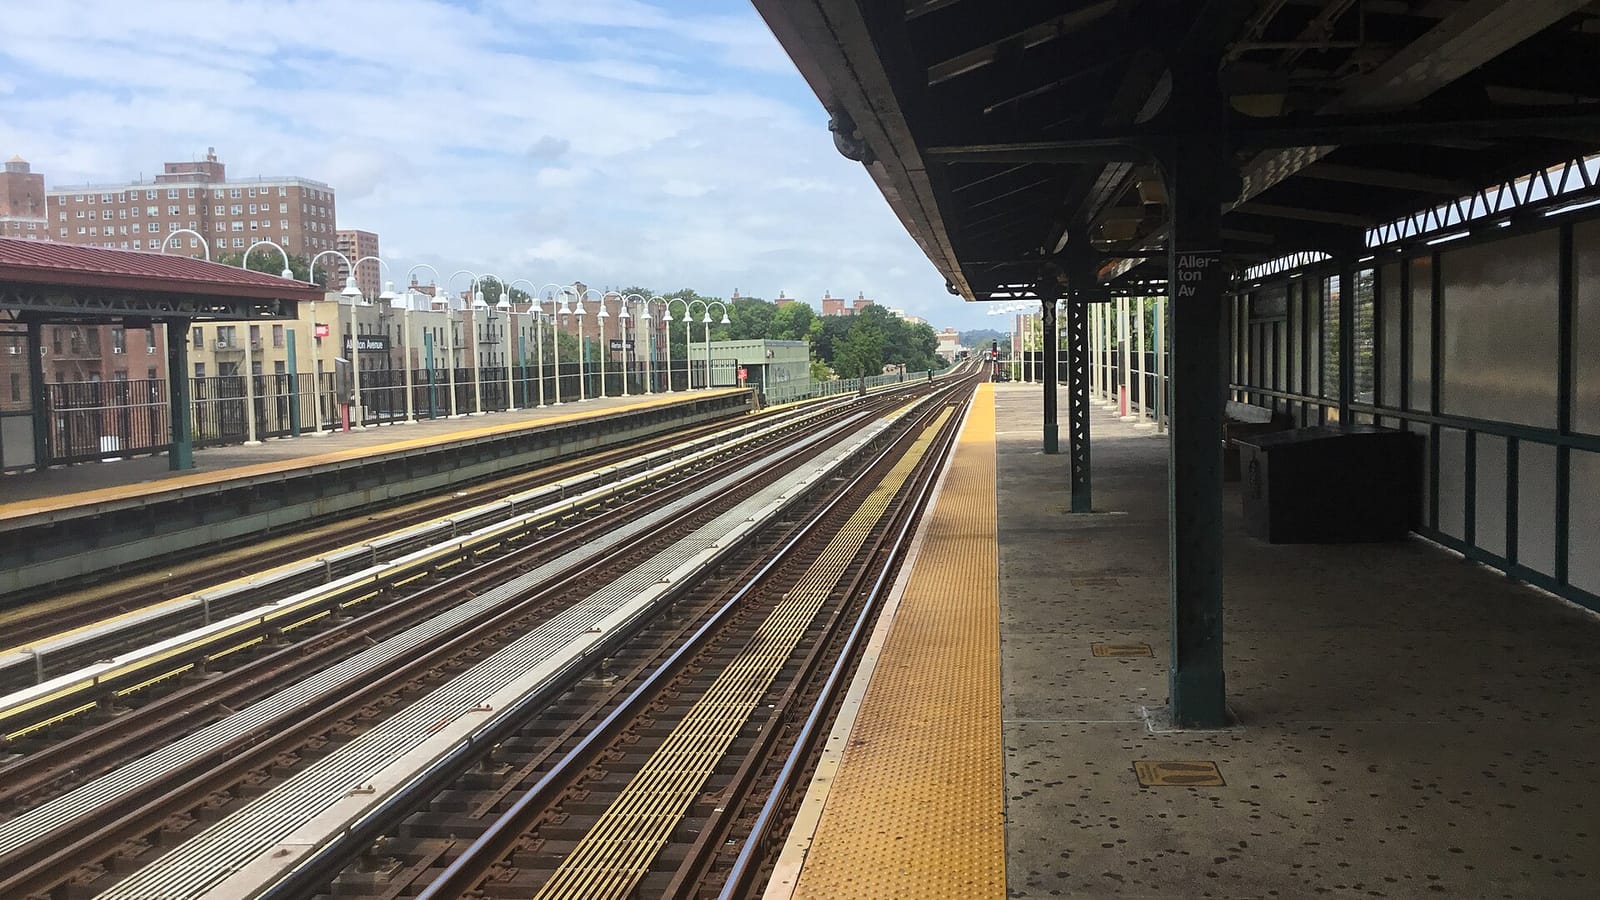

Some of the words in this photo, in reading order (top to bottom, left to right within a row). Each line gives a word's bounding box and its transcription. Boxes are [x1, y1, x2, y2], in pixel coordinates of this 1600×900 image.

[1178, 256, 1219, 268] Aller-
[1178, 270, 1202, 281] ton
[1178, 284, 1196, 297] Av
